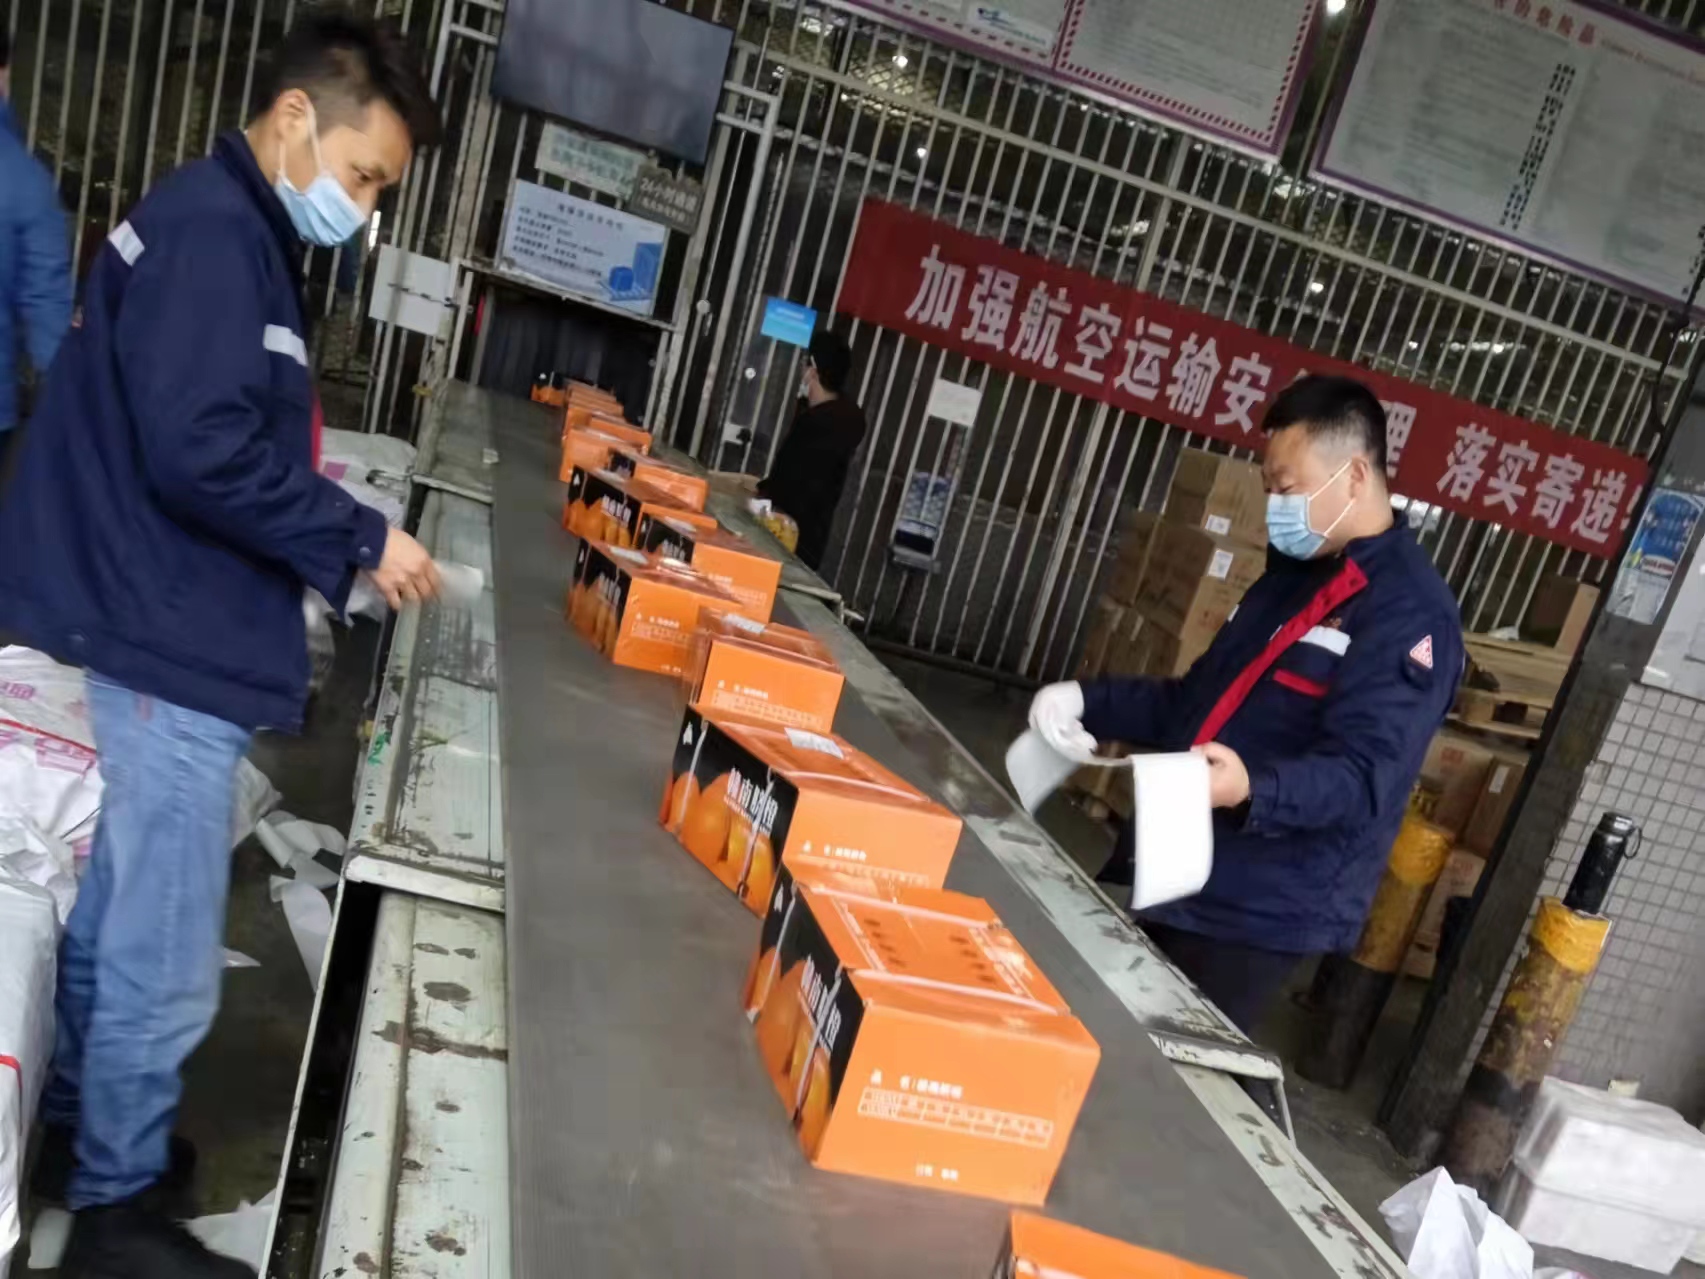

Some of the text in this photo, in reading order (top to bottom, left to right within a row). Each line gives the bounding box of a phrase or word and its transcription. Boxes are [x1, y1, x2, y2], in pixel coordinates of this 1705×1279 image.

[905, 244, 1416, 479] 加强航空运输安理
[1436, 422, 1643, 543] 落实寄递
